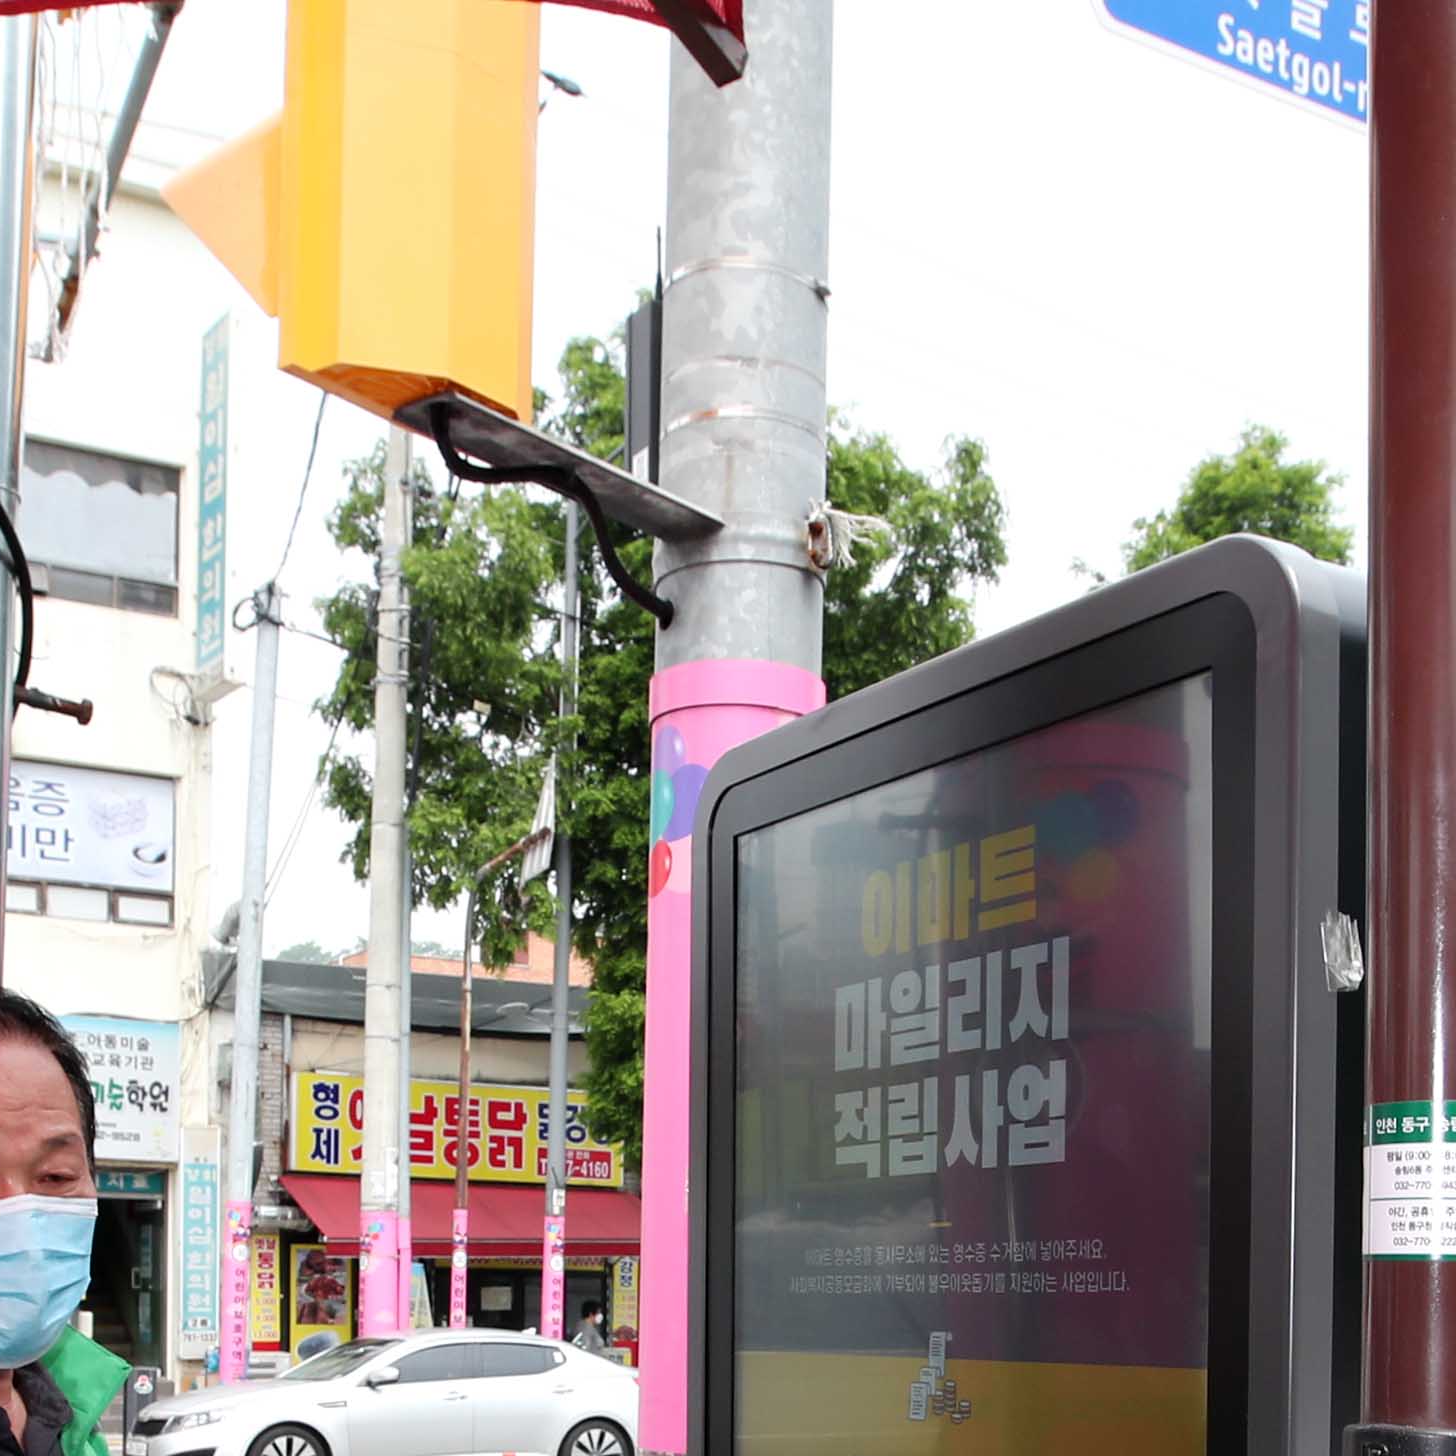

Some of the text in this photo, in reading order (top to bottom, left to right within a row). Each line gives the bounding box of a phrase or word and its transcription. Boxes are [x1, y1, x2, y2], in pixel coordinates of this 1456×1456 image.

[861, 824, 1037, 958] 이마트
[834, 936, 1070, 1072] 마일리지
[834, 1058, 1068, 1179] 적립사업
[1376, 1118, 1397, 1134] 인천
[1402, 1116, 1430, 1133] 동구
[953, 1241, 986, 1264] 영수증
[1009, 1272, 1057, 1293] 지원하는
[1062, 1270, 1131, 1293] 사업입니다.
